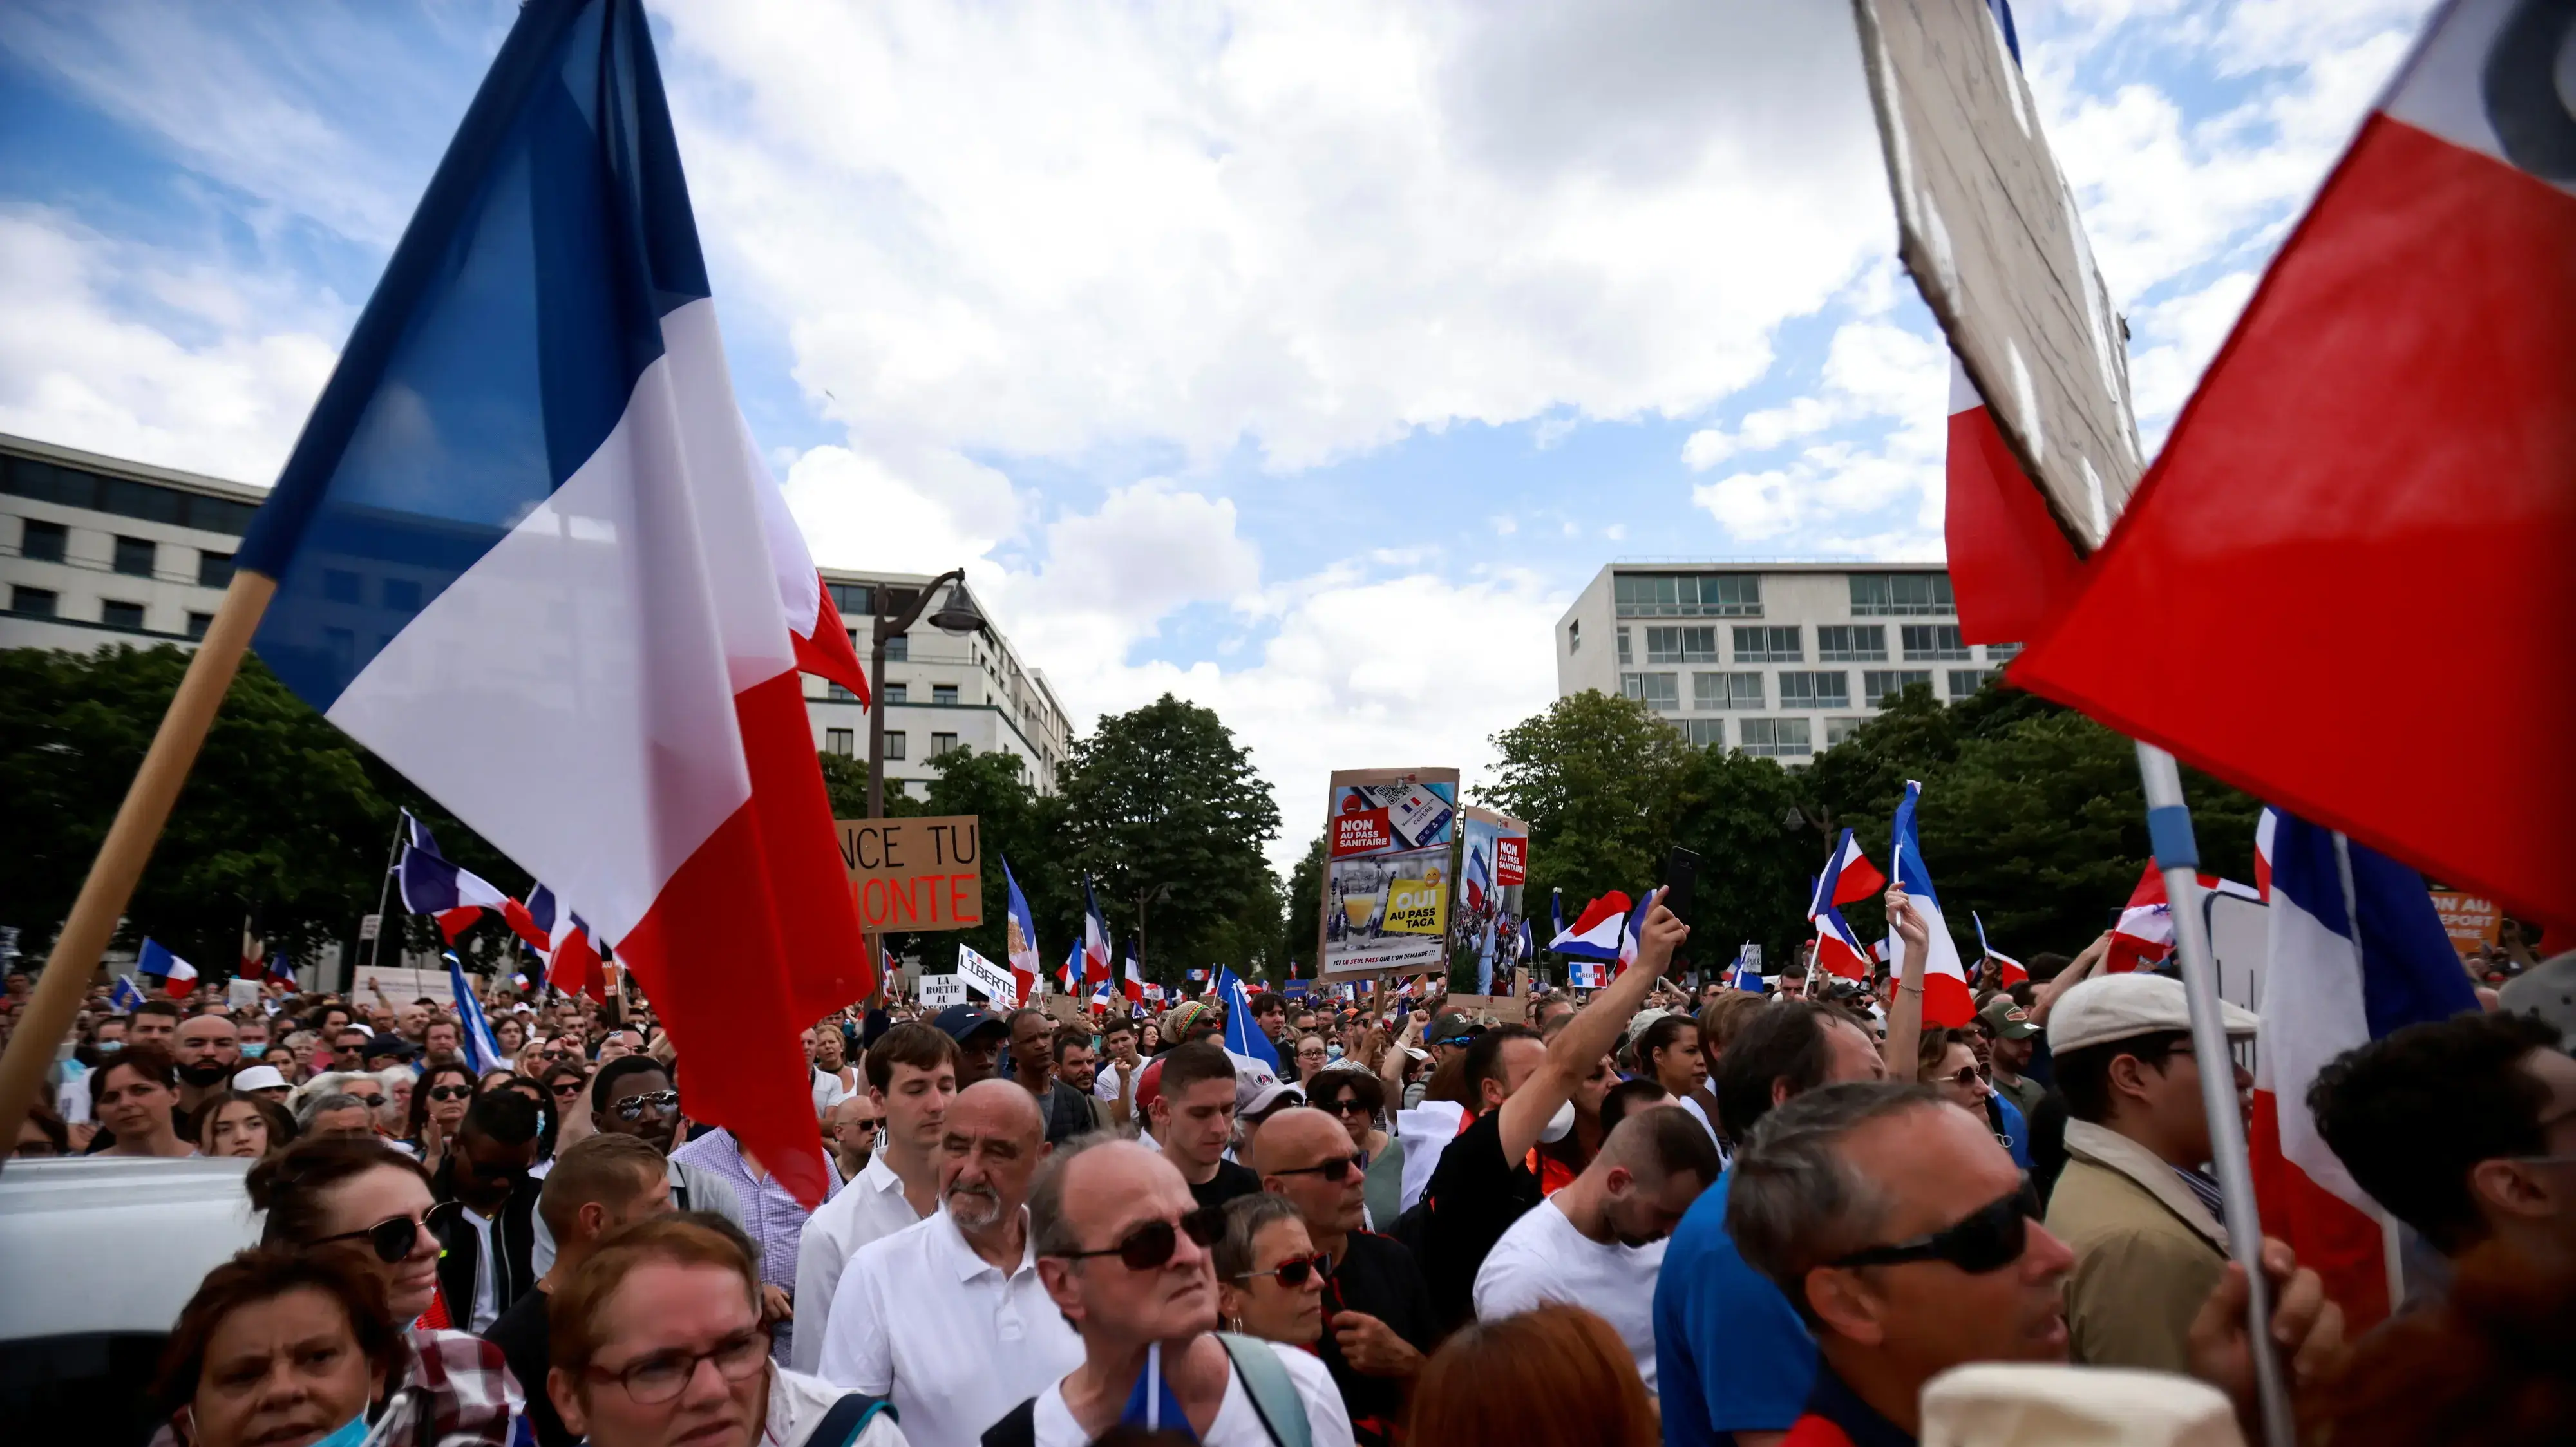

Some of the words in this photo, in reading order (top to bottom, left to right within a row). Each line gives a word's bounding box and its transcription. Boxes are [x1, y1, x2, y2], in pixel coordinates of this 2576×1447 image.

[1413, 806, 1434, 825] certifié
[1341, 819, 1374, 831] NON
[1356, 830, 1379, 838] PASS
[927, 824, 976, 864] TU
[1340, 838, 1387, 847] SANITAIRE
[1500, 841, 1517, 856] NON
[1507, 855, 1520, 865] PASS
[1499, 861, 1524, 873] SANITAIRE
[1396, 889, 1437, 910] OUI
[2461, 898, 2492, 913] AU
[1390, 911, 1405, 921] AU
[1408, 907, 1436, 918] PASS
[1406, 917, 1435, 929] TAGA
[1404, 950, 1428, 959] DEMANDE
[938, 976, 950, 985] LA
[960, 954, 1016, 998] LIBERTE
[936, 995, 949, 1003] AU
